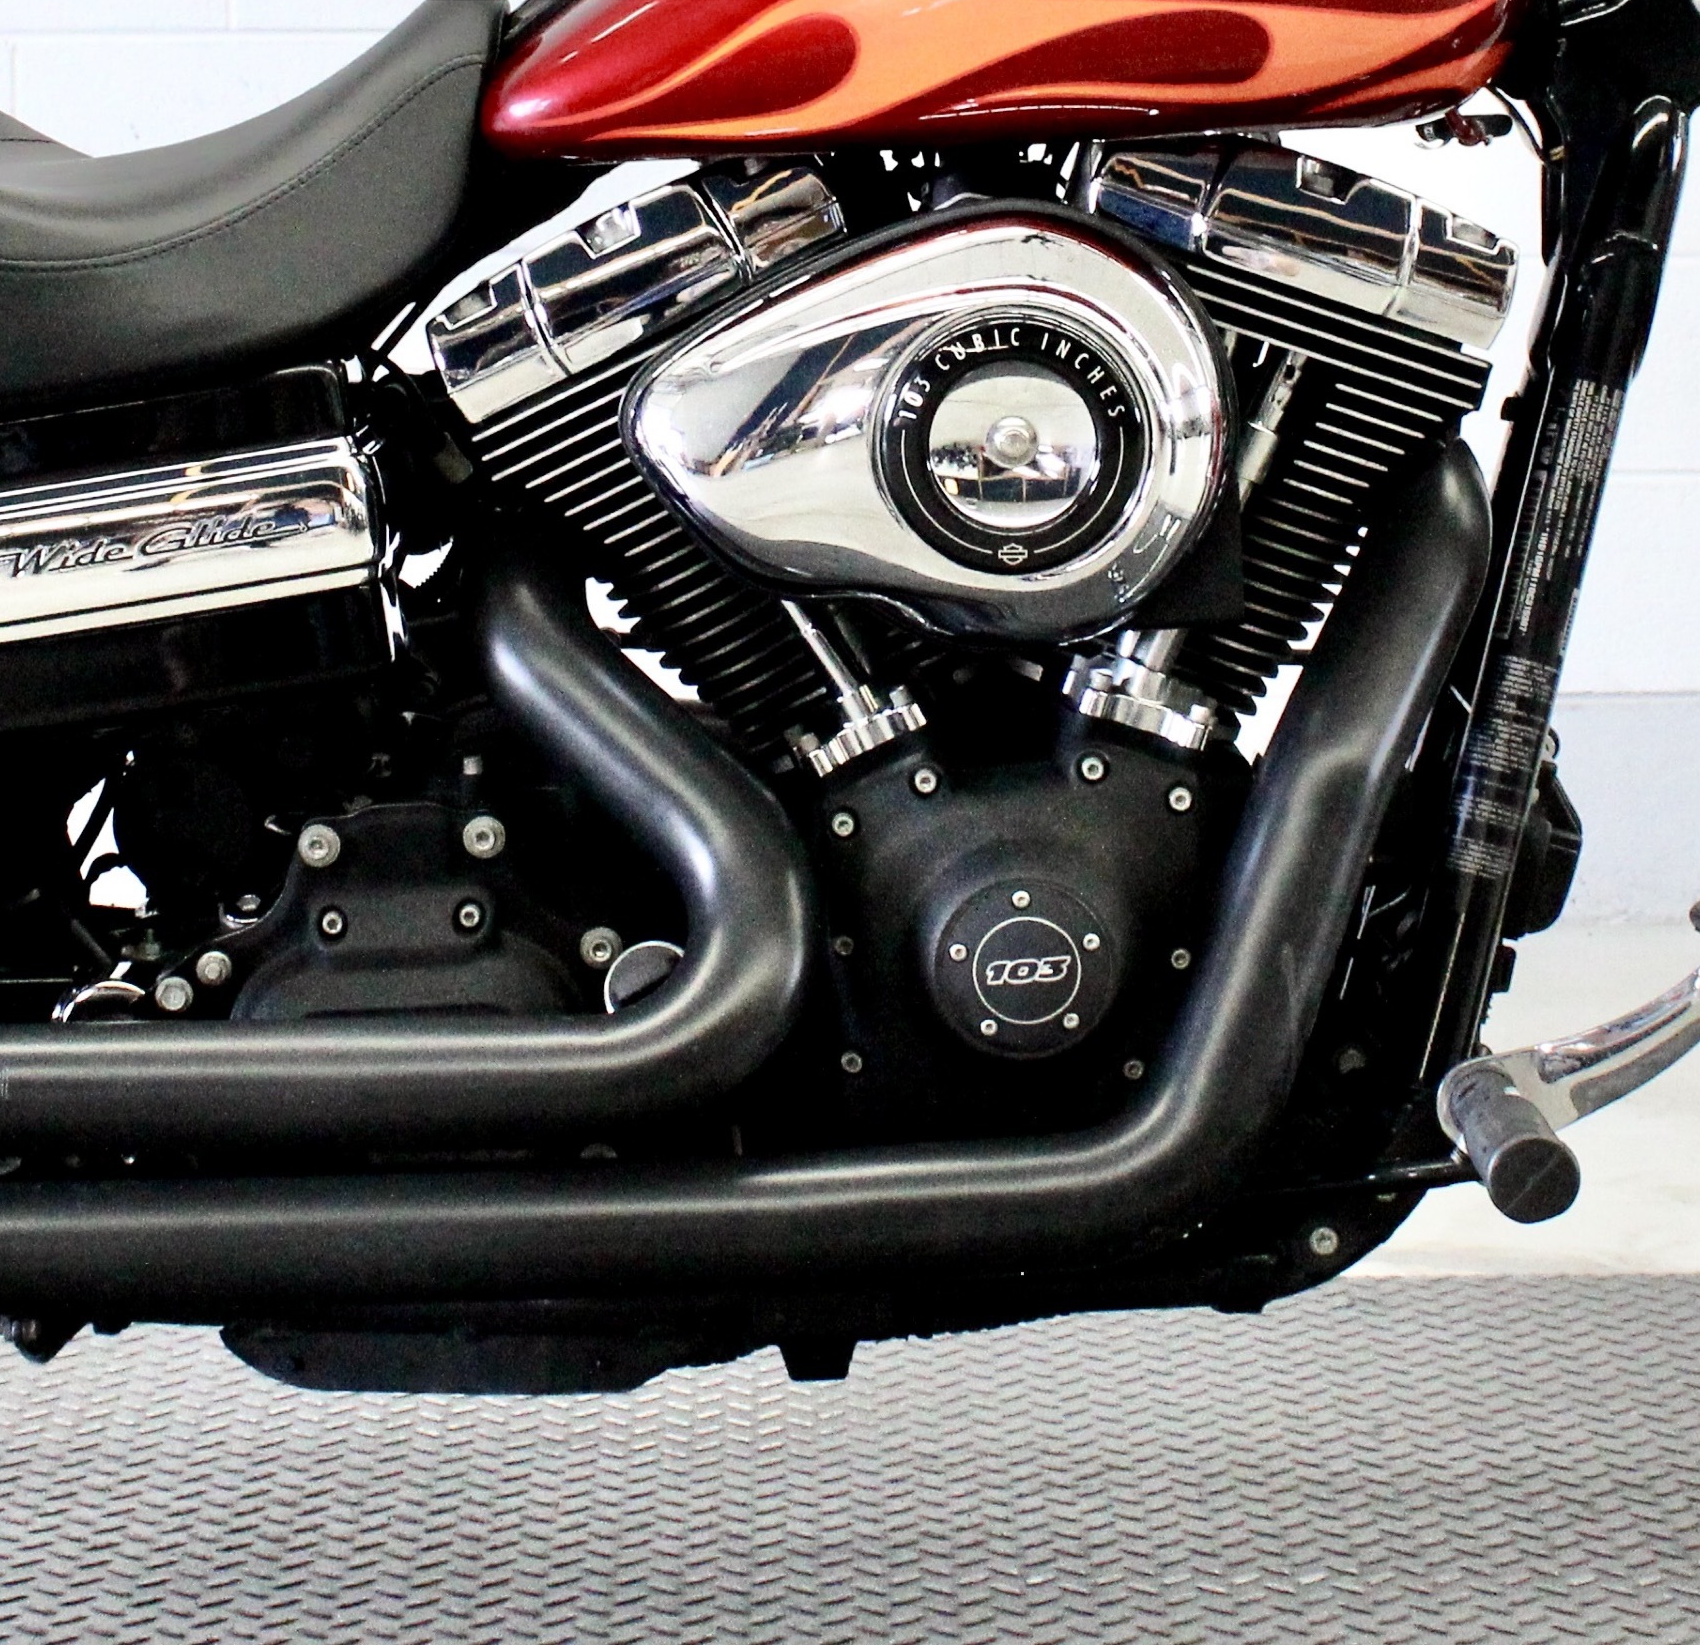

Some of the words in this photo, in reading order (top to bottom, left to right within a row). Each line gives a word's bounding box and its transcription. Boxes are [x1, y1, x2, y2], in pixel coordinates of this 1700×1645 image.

[898, 376, 931, 420] 103
[934, 327, 1021, 371] CUBIC
[1040, 332, 1126, 419] INCHES
[134, 515, 309, 558] Glide
[986, 955, 1072, 986] 103
